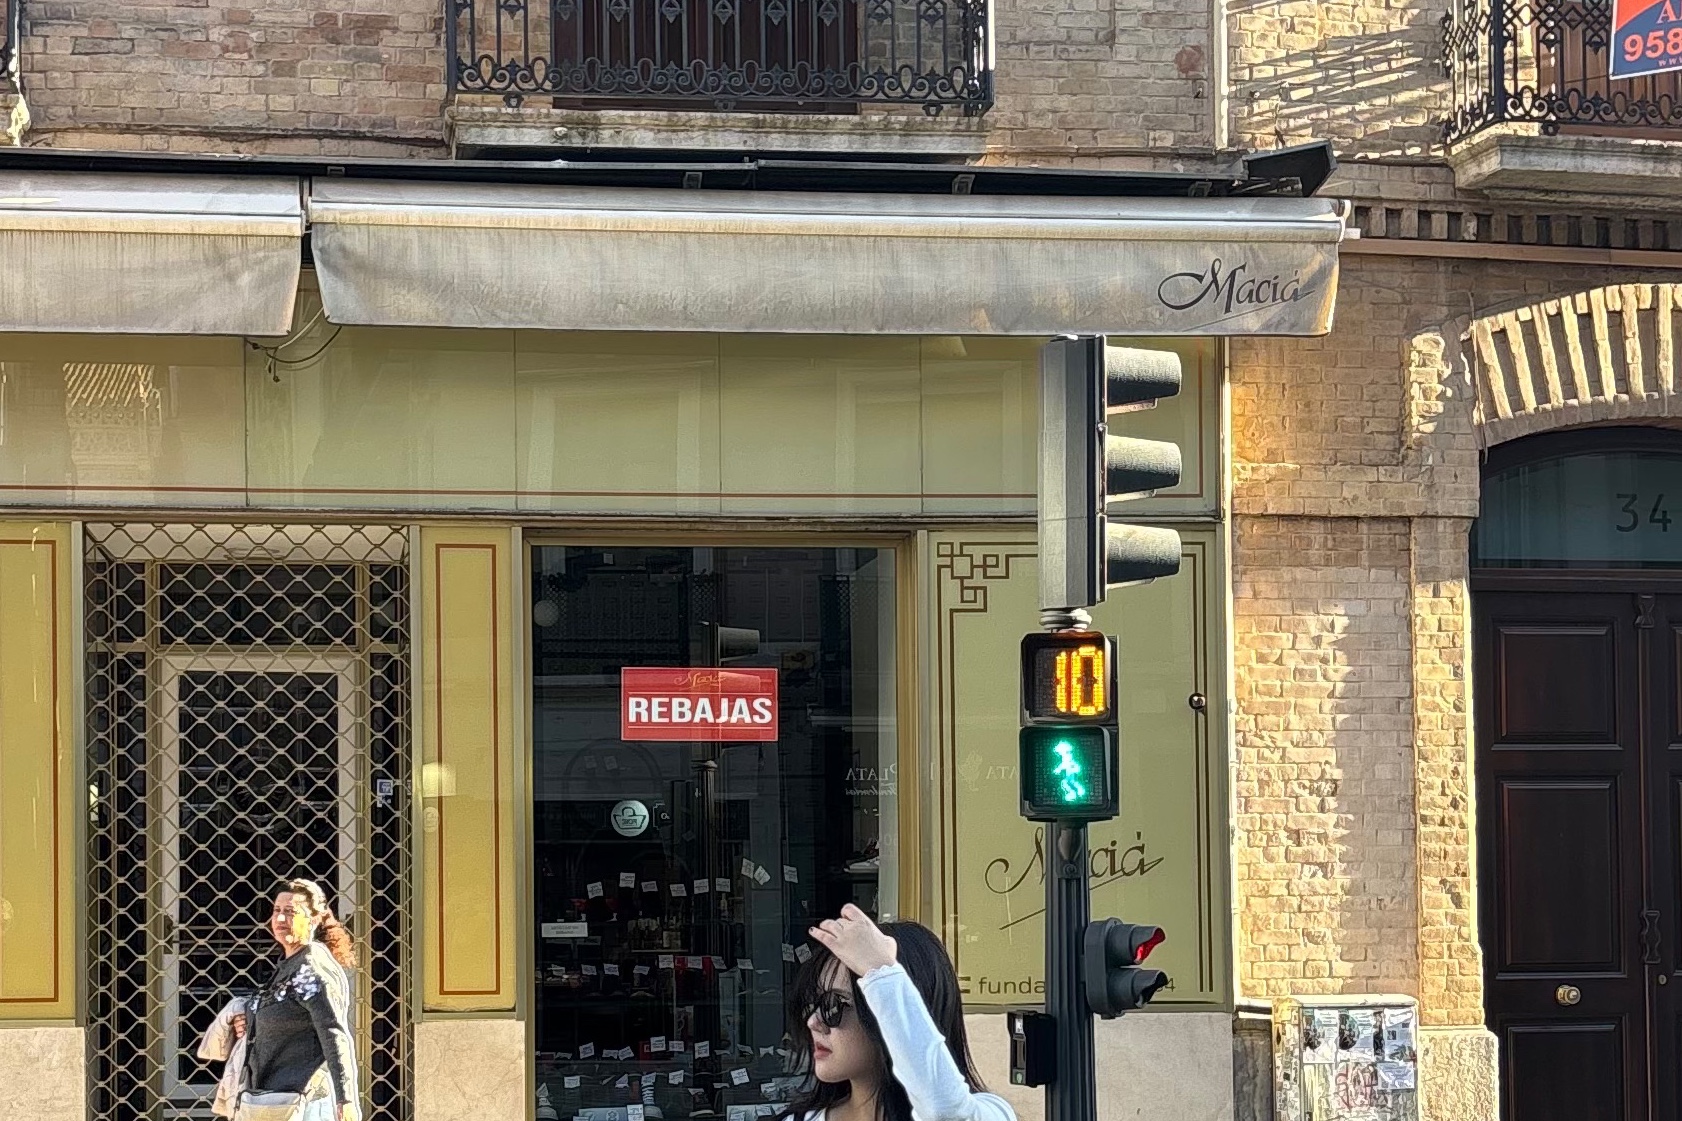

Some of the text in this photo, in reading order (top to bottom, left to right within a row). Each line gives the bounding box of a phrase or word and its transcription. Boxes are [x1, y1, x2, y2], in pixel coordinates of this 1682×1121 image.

[1615, 493, 1672, 533] 34
[1056, 646, 1104, 716] 10
[628, 697, 773, 724] REBAJAS
